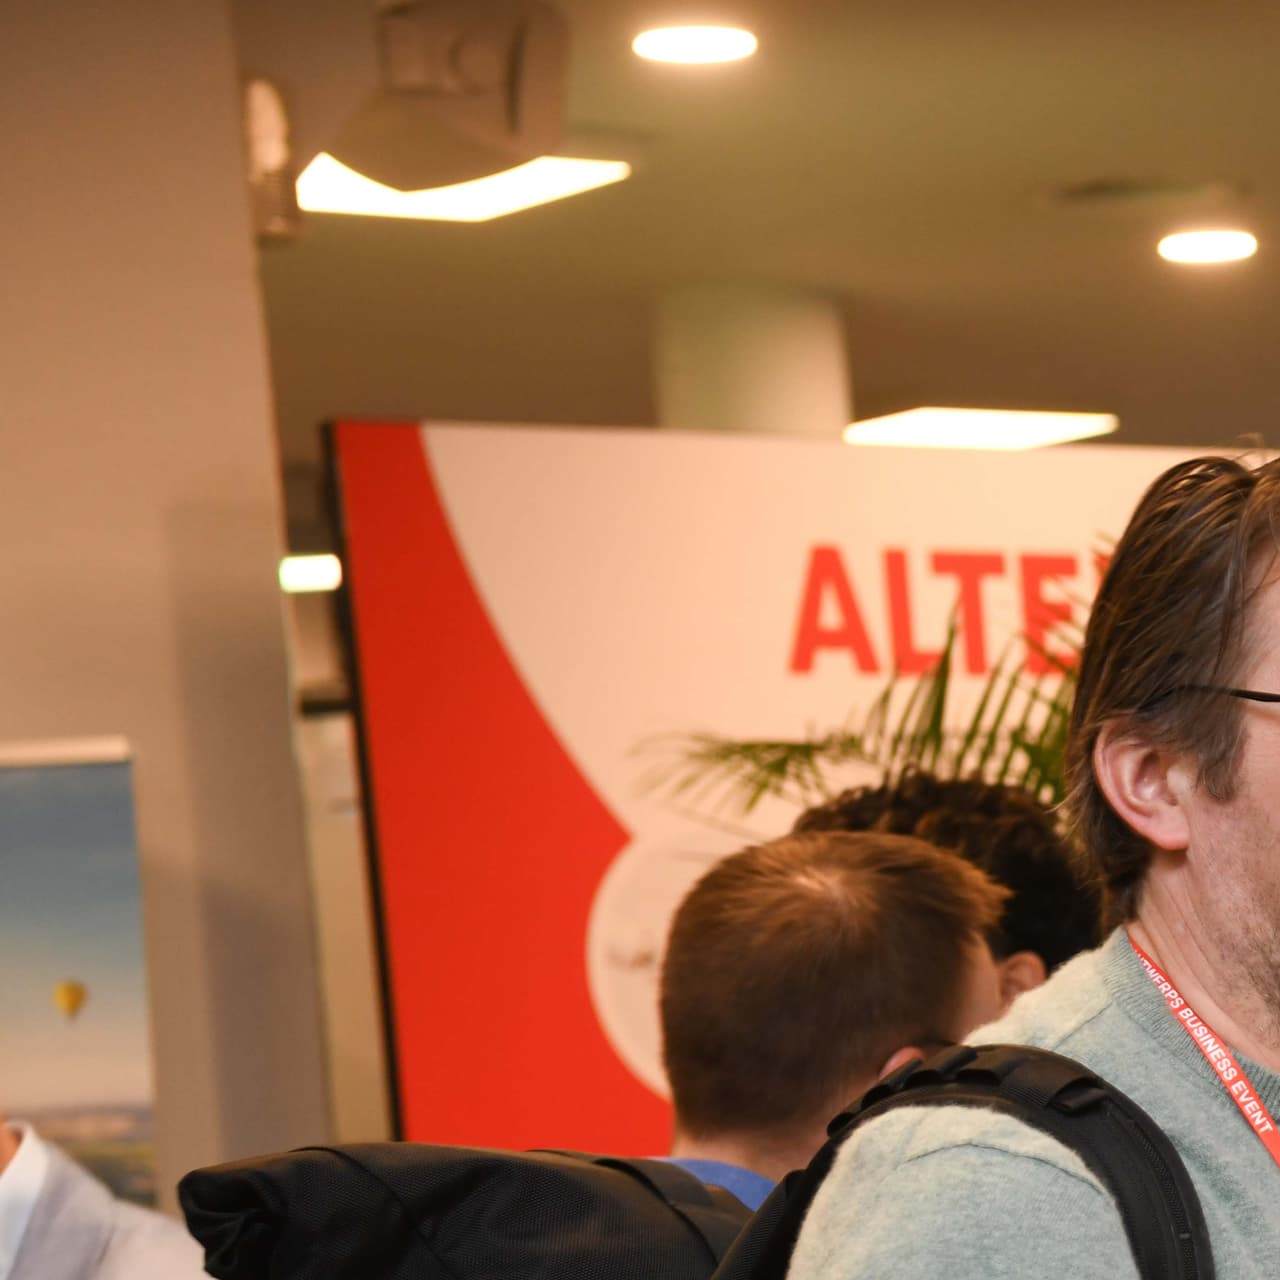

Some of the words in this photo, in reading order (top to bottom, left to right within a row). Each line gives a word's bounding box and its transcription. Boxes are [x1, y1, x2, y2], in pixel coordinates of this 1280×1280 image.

[788, 543, 1116, 677] ALTE
[1137, 952, 1185, 1010] TWERPS
[1178, 1007, 1238, 1081] BUSINESS
[1231, 1080, 1274, 1133] EVENT
